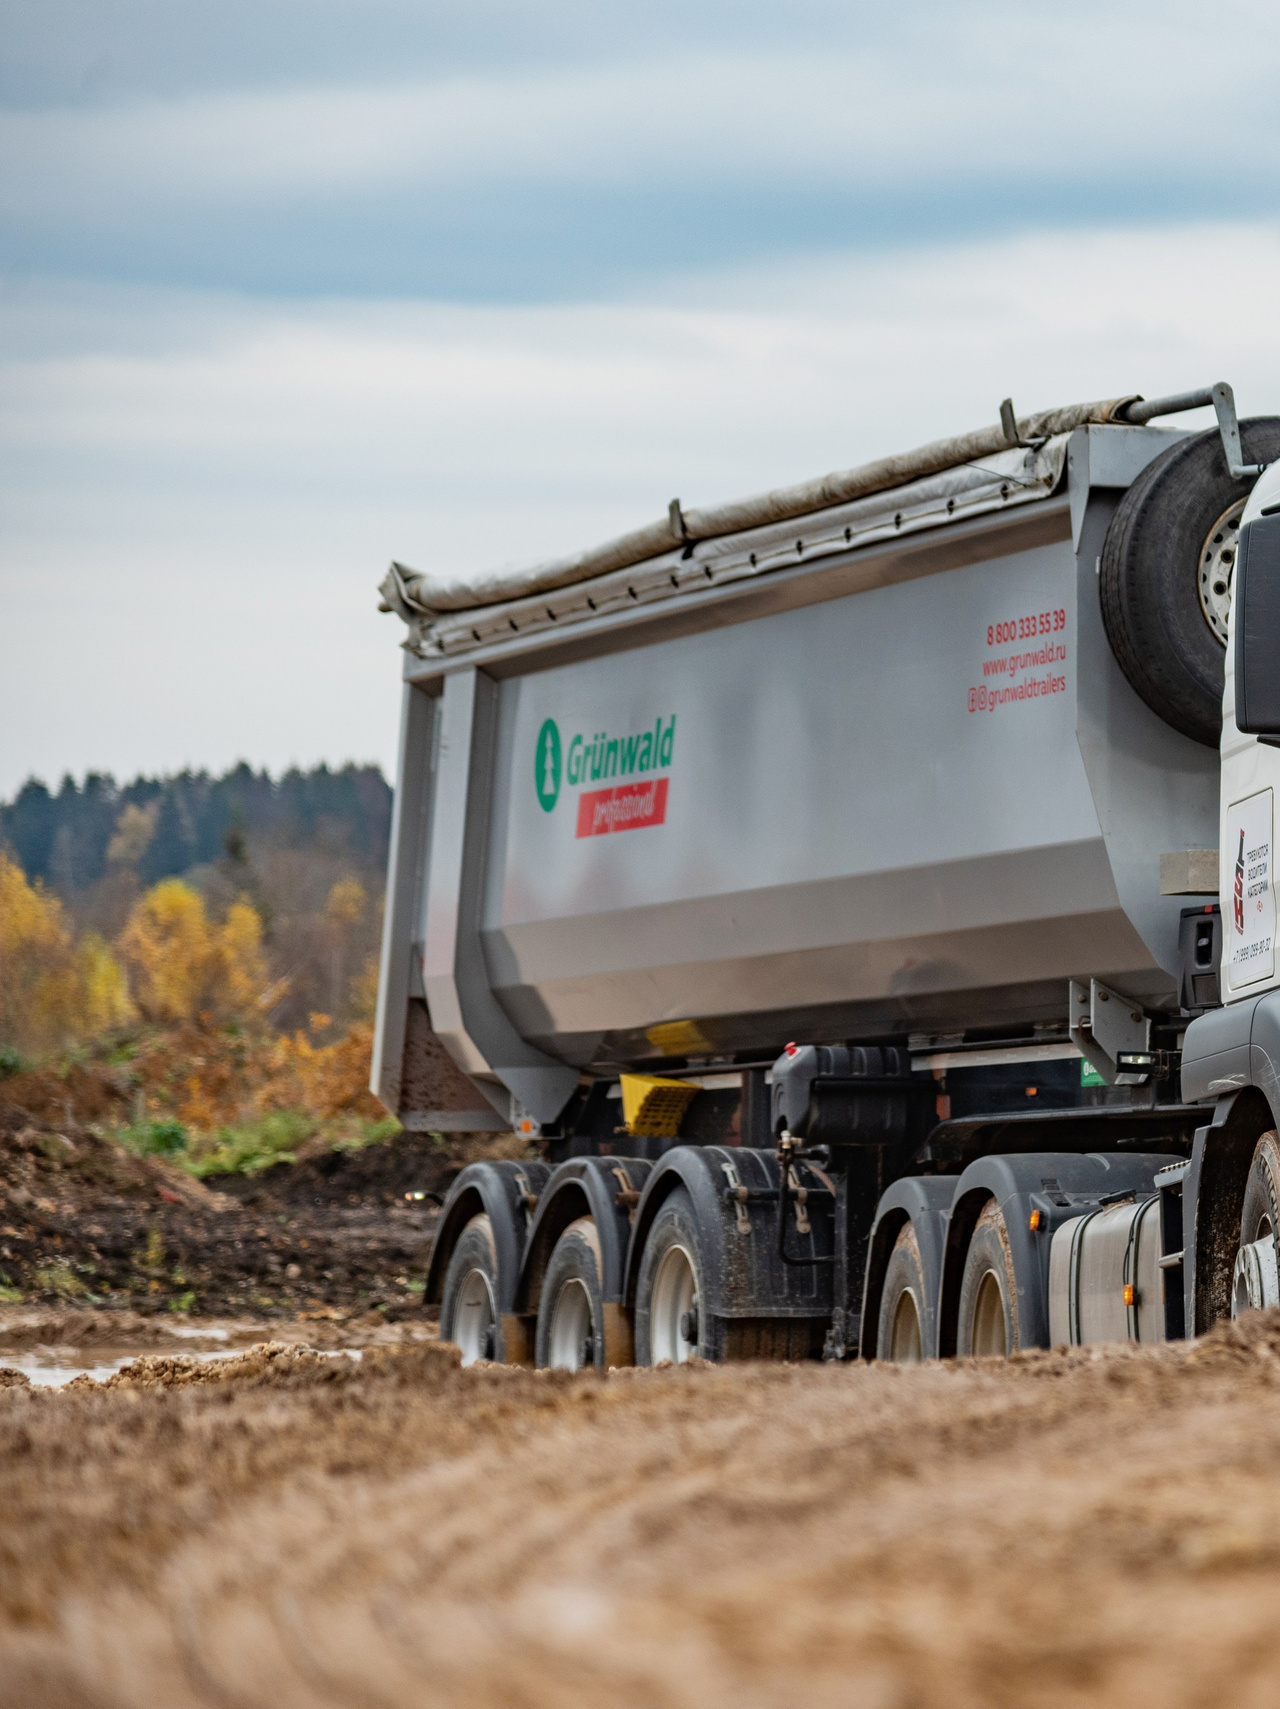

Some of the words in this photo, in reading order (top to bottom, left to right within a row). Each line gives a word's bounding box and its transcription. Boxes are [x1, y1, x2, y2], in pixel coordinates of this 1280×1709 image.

[987, 625, 994, 646] 8
[995, 620, 1017, 644] 800
[1018, 615, 1037, 639] 333
[1039, 612, 1051, 635] 55
[1053, 608, 1066, 631] 39
[982, 641, 1066, 677] www.grunwald.ru
[567, 714, 676, 785] Grünwald
